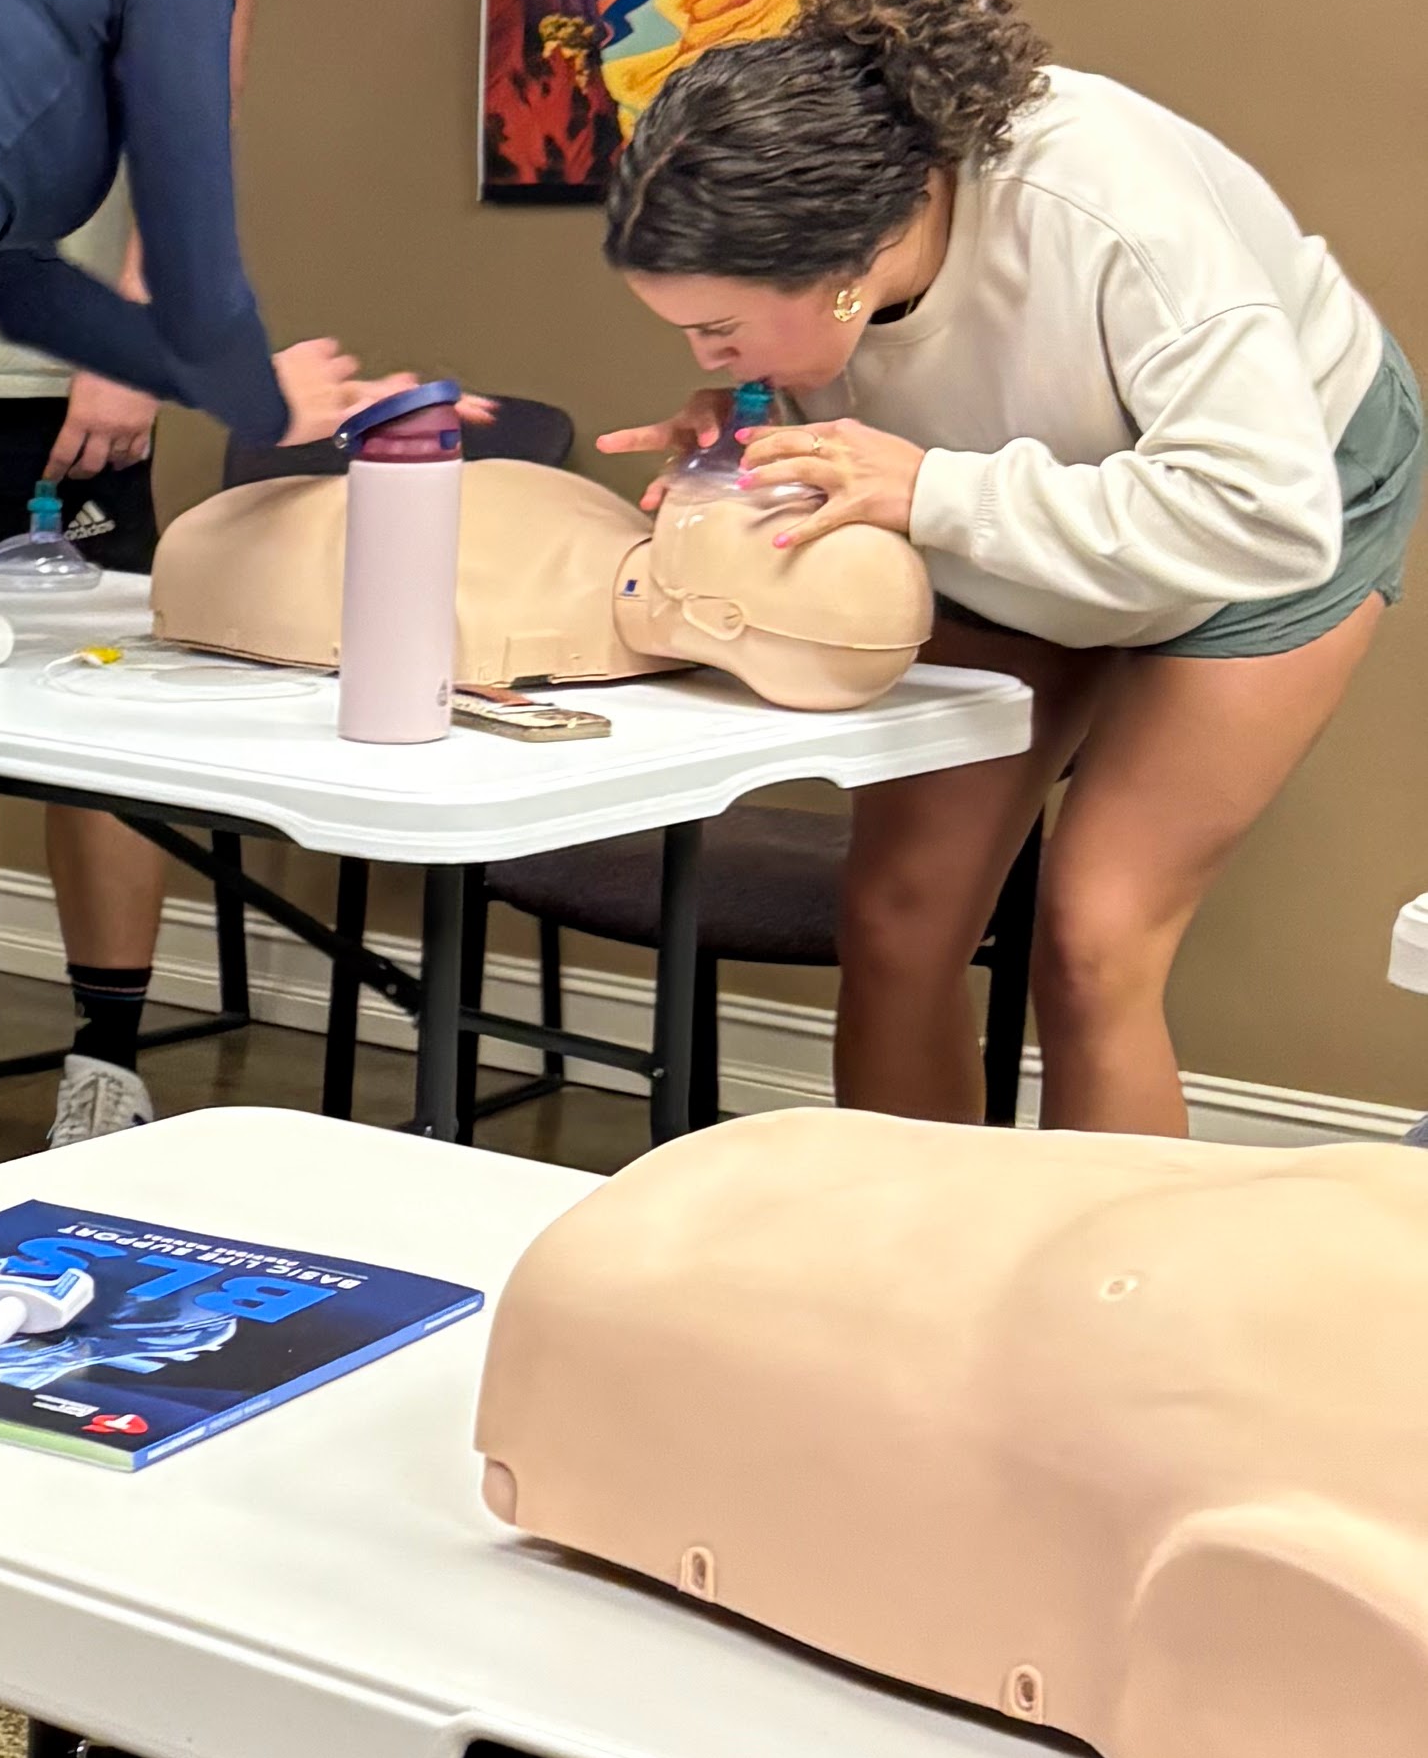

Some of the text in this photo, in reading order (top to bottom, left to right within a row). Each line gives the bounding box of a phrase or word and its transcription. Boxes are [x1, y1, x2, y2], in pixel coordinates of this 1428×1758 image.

[5, 1237, 338, 1323] BLS
[57, 1225, 362, 1289] BASIC LIFE SUPPORT
